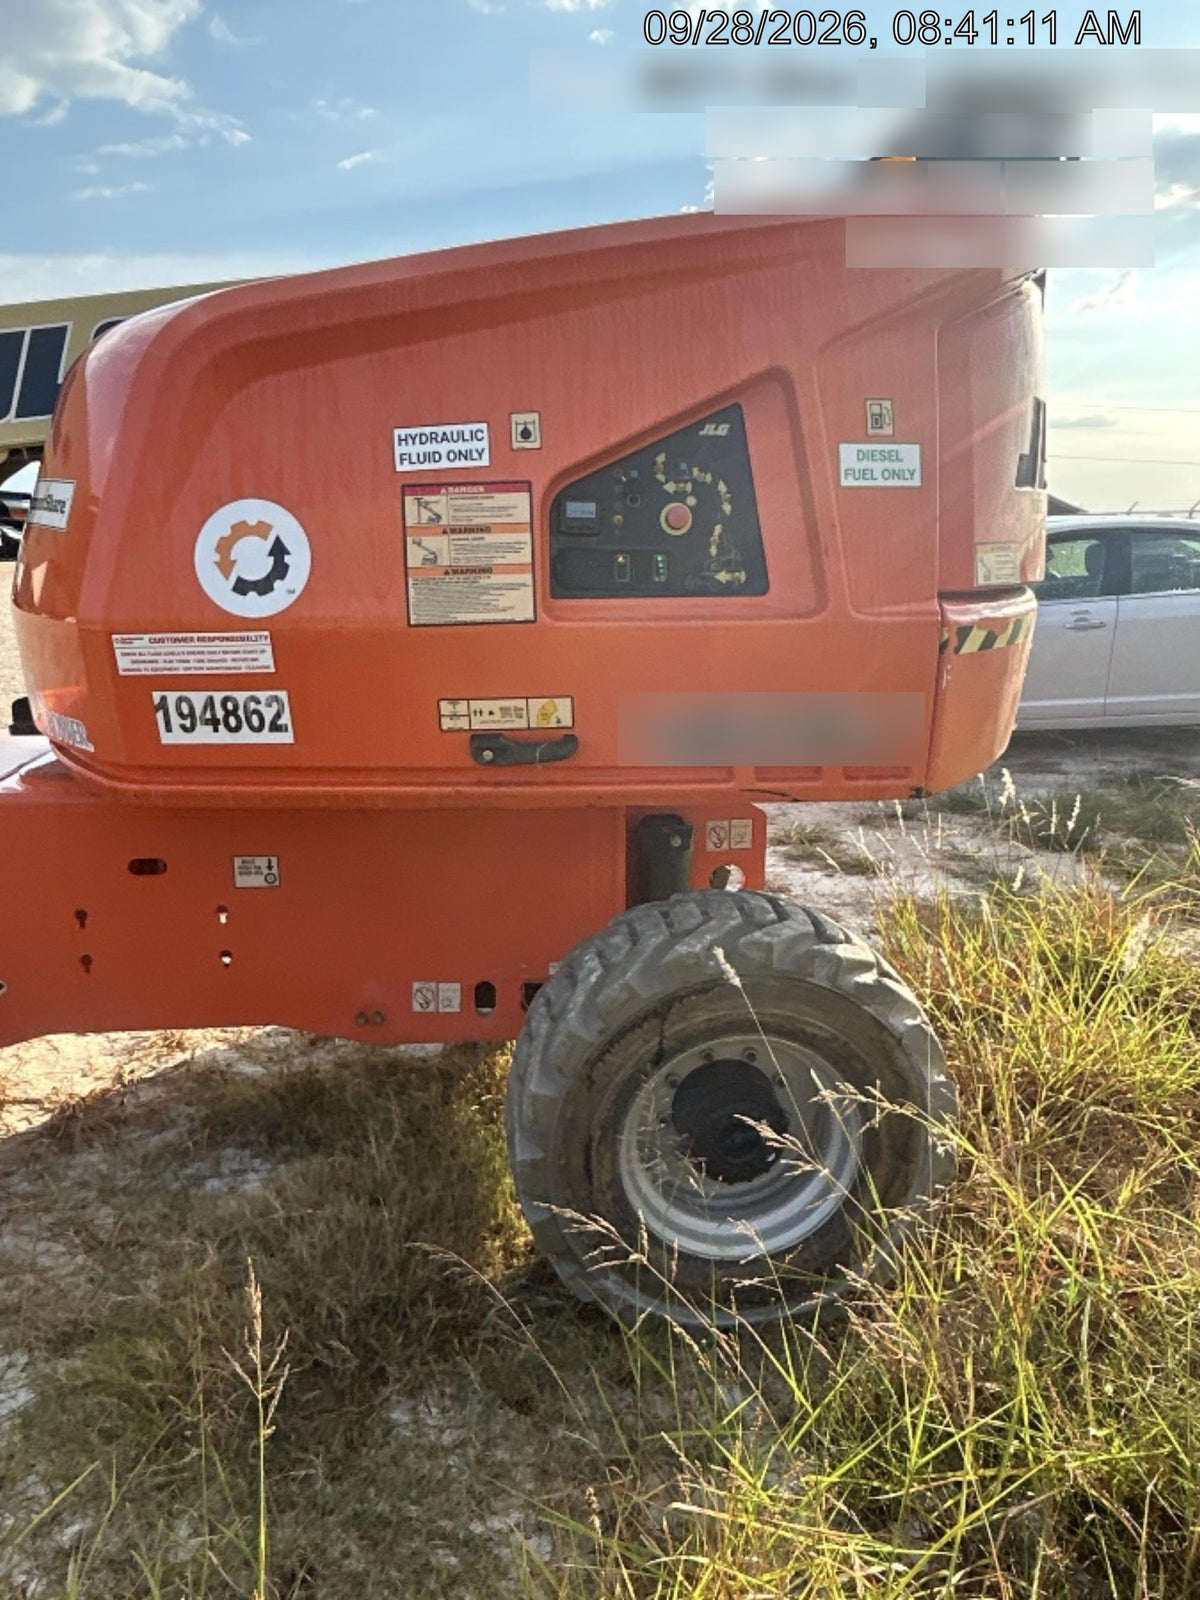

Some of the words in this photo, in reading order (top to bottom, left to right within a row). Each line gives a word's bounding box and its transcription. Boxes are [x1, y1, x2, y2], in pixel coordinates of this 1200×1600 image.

[698, 423, 730, 436] JLG
[397, 428, 485, 446] HYDRAULIC
[399, 450, 442, 466] FLUID
[446, 447, 486, 463] ONLY
[856, 449, 904, 462] DIESEL
[843, 468, 878, 481] FUEL
[881, 468, 916, 481] ONLY
[449, 525, 492, 535] WARNING
[451, 566, 493, 575] WARNING
[148, 635, 196, 644] CUSTOMER
[196, 634, 269, 643] RESPONSIBILITY
[154, 694, 289, 734] 194862
